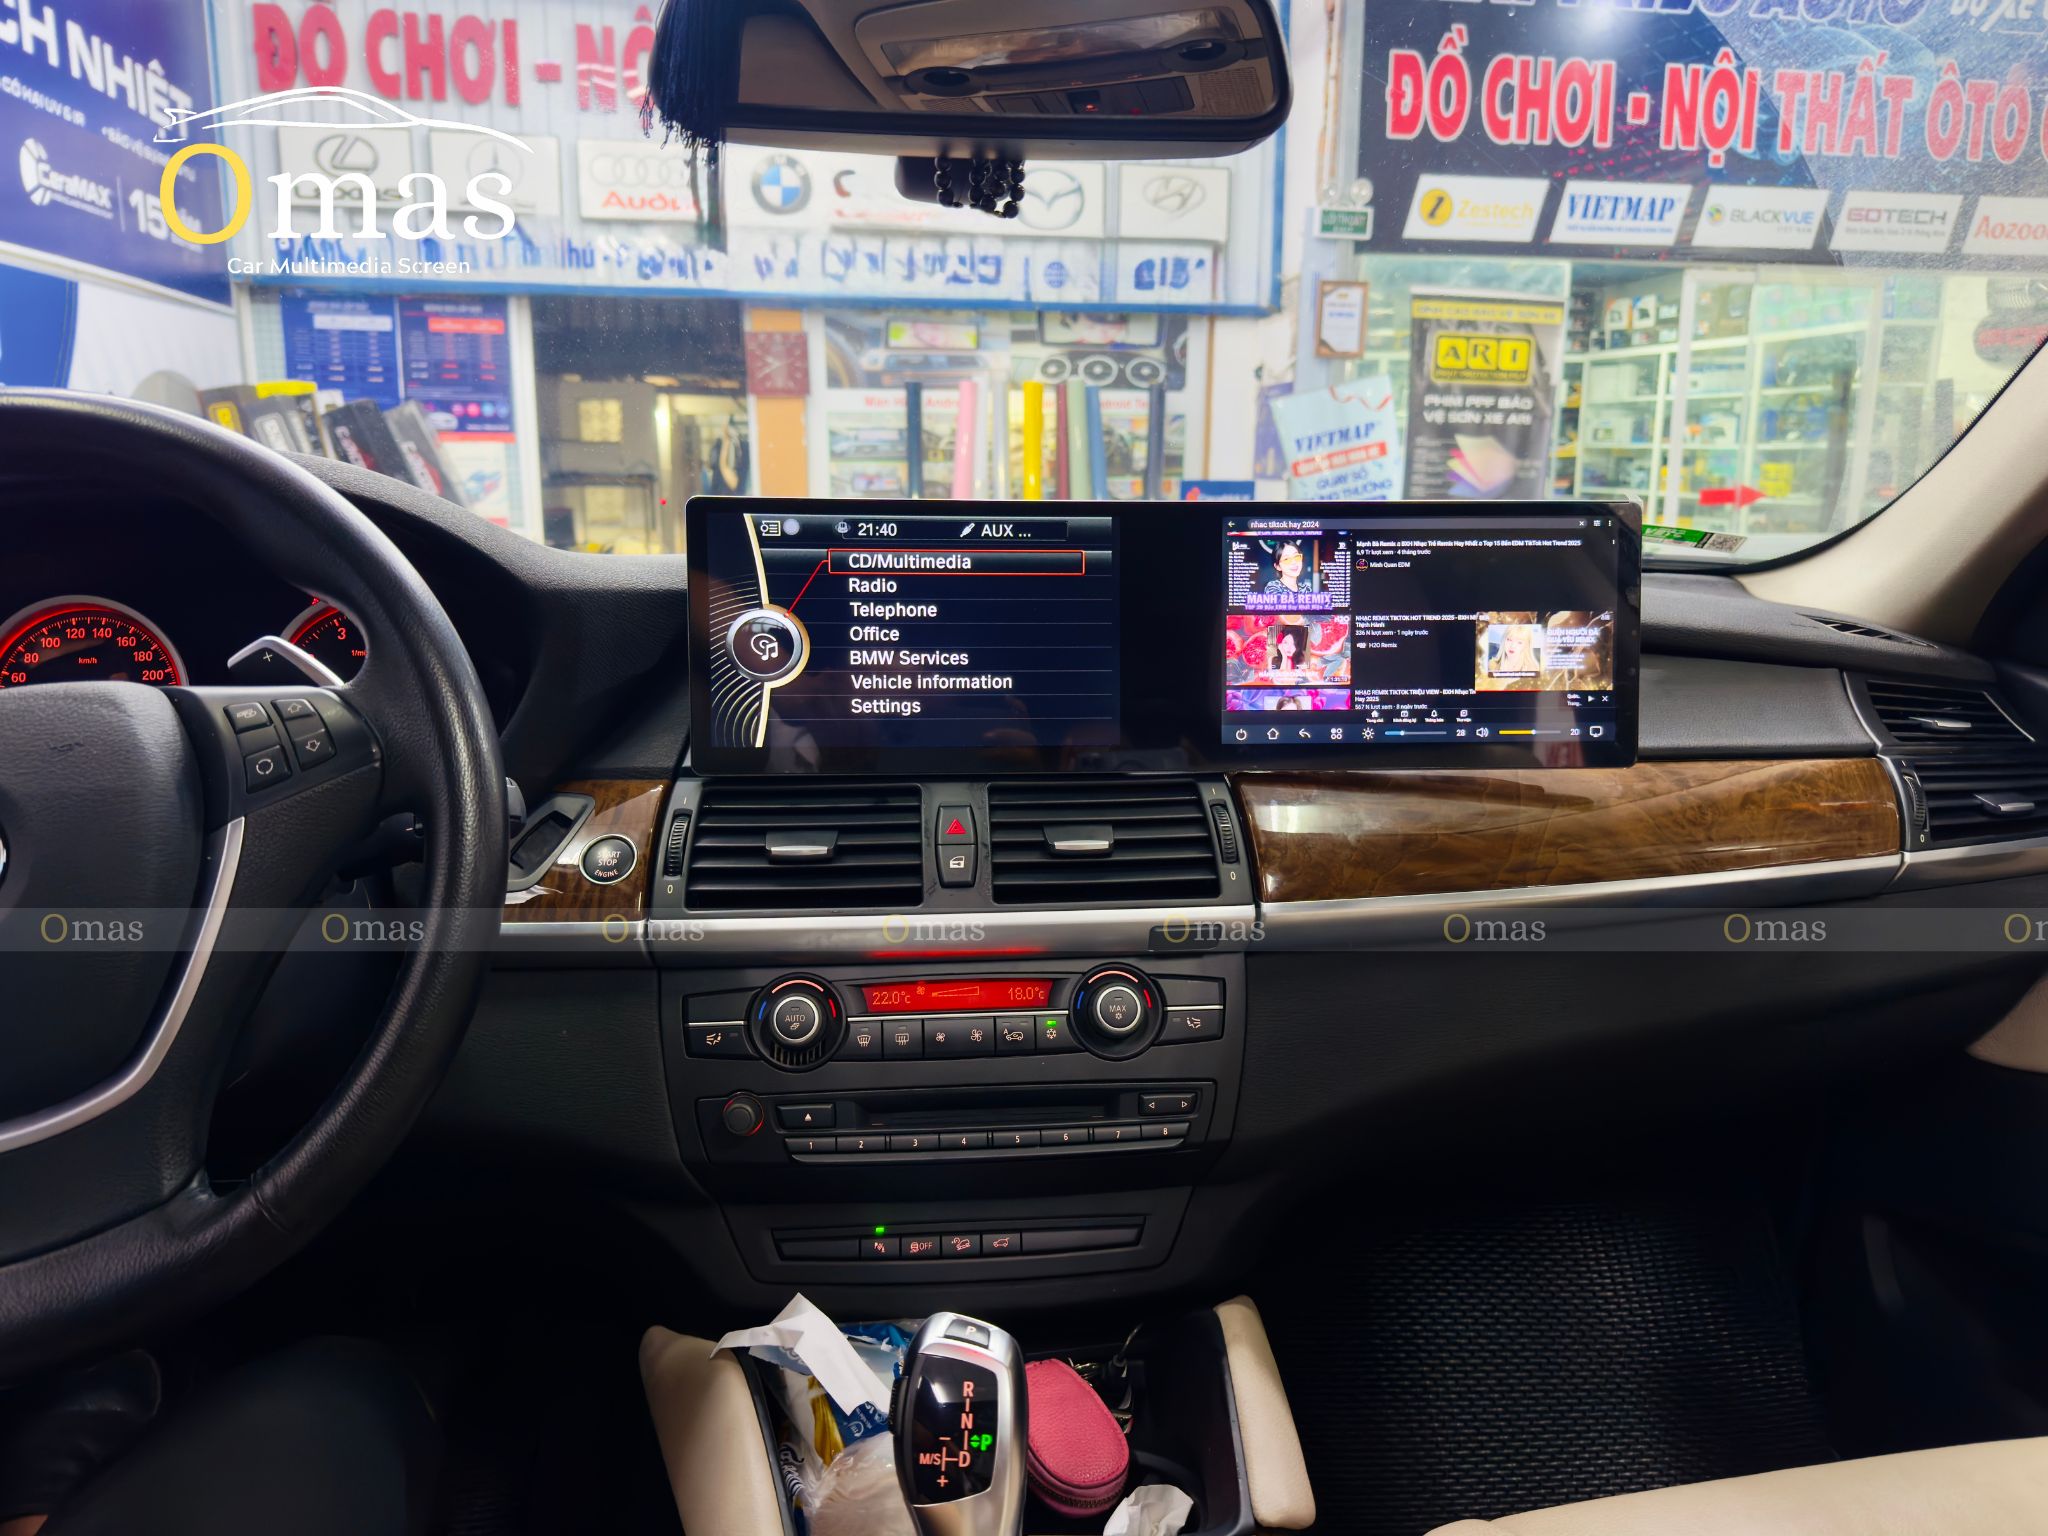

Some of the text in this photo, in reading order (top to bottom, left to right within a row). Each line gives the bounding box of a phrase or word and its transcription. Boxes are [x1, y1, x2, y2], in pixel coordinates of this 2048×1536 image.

[365, 9, 521, 107] CHƠI
[66, 19, 193, 140] NHIỆT
[1386, 24, 1471, 142] ĐỒ
[1481, 53, 1616, 148] CHƠI
[1660, 47, 1761, 168] NỘI
[1774, 51, 1915, 158] THẤT
[602, 191, 680, 211] Audi
[1457, 200, 1534, 221] Zestech
[1567, 193, 1675, 221] VIETMAP
[1730, 208, 1815, 226] BLACKVUE
[1295, 422, 1375, 452] VIETMAP
[1250, 520, 1319, 529] nhac tiktok hay 2024
[858, 523, 1013, 538] 21:40 AUX
[849, 553, 972, 570] CD/Multimedia
[849, 578, 897, 594] Radio
[1299, 593, 1332, 604] REMIX
[849, 602, 938, 619] Telephone
[65, 628, 85, 639] 120
[92, 628, 112, 639] 140
[337, 628, 347, 640] 3
[849, 626, 899, 641] Office
[40, 637, 61, 649] 100
[116, 636, 136, 647] 160
[24, 652, 39, 664] 80
[78, 656, 98, 665] km/h
[133, 651, 153, 662] 180
[849, 650, 969, 666] BMW Services
[11, 672, 26, 683] 60
[142, 670, 164, 681] 200
[851, 674, 1013, 690] Vehicle information
[851, 698, 921, 716] Settings
[1456, 728, 1466, 737] 28
[1570, 728, 1580, 736] 20
[598, 858, 618, 866] STOP
[594, 868, 619, 878] ENGINE
[1109, 1004, 1127, 1013] MAX
[785, 1014, 806, 1023] AUTO
[1063, 1133, 1068, 1141] 6
[1115, 1130, 1120, 1139] 7
[1163, 1127, 1168, 1136] 8
[859, 1141, 864, 1149] 2
[913, 1139, 918, 1147] 3
[961, 1137, 967, 1146] 4
[1015, 1135, 1020, 1144] 5
[809, 1142, 814, 1150] 1
[920, 1241, 933, 1250] OFF
[966, 1325, 976, 1337] P
[963, 1380, 974, 1397] R
[960, 1413, 973, 1430] N
[980, 1434, 993, 1450] P
[919, 1451, 971, 1468] M/S D
